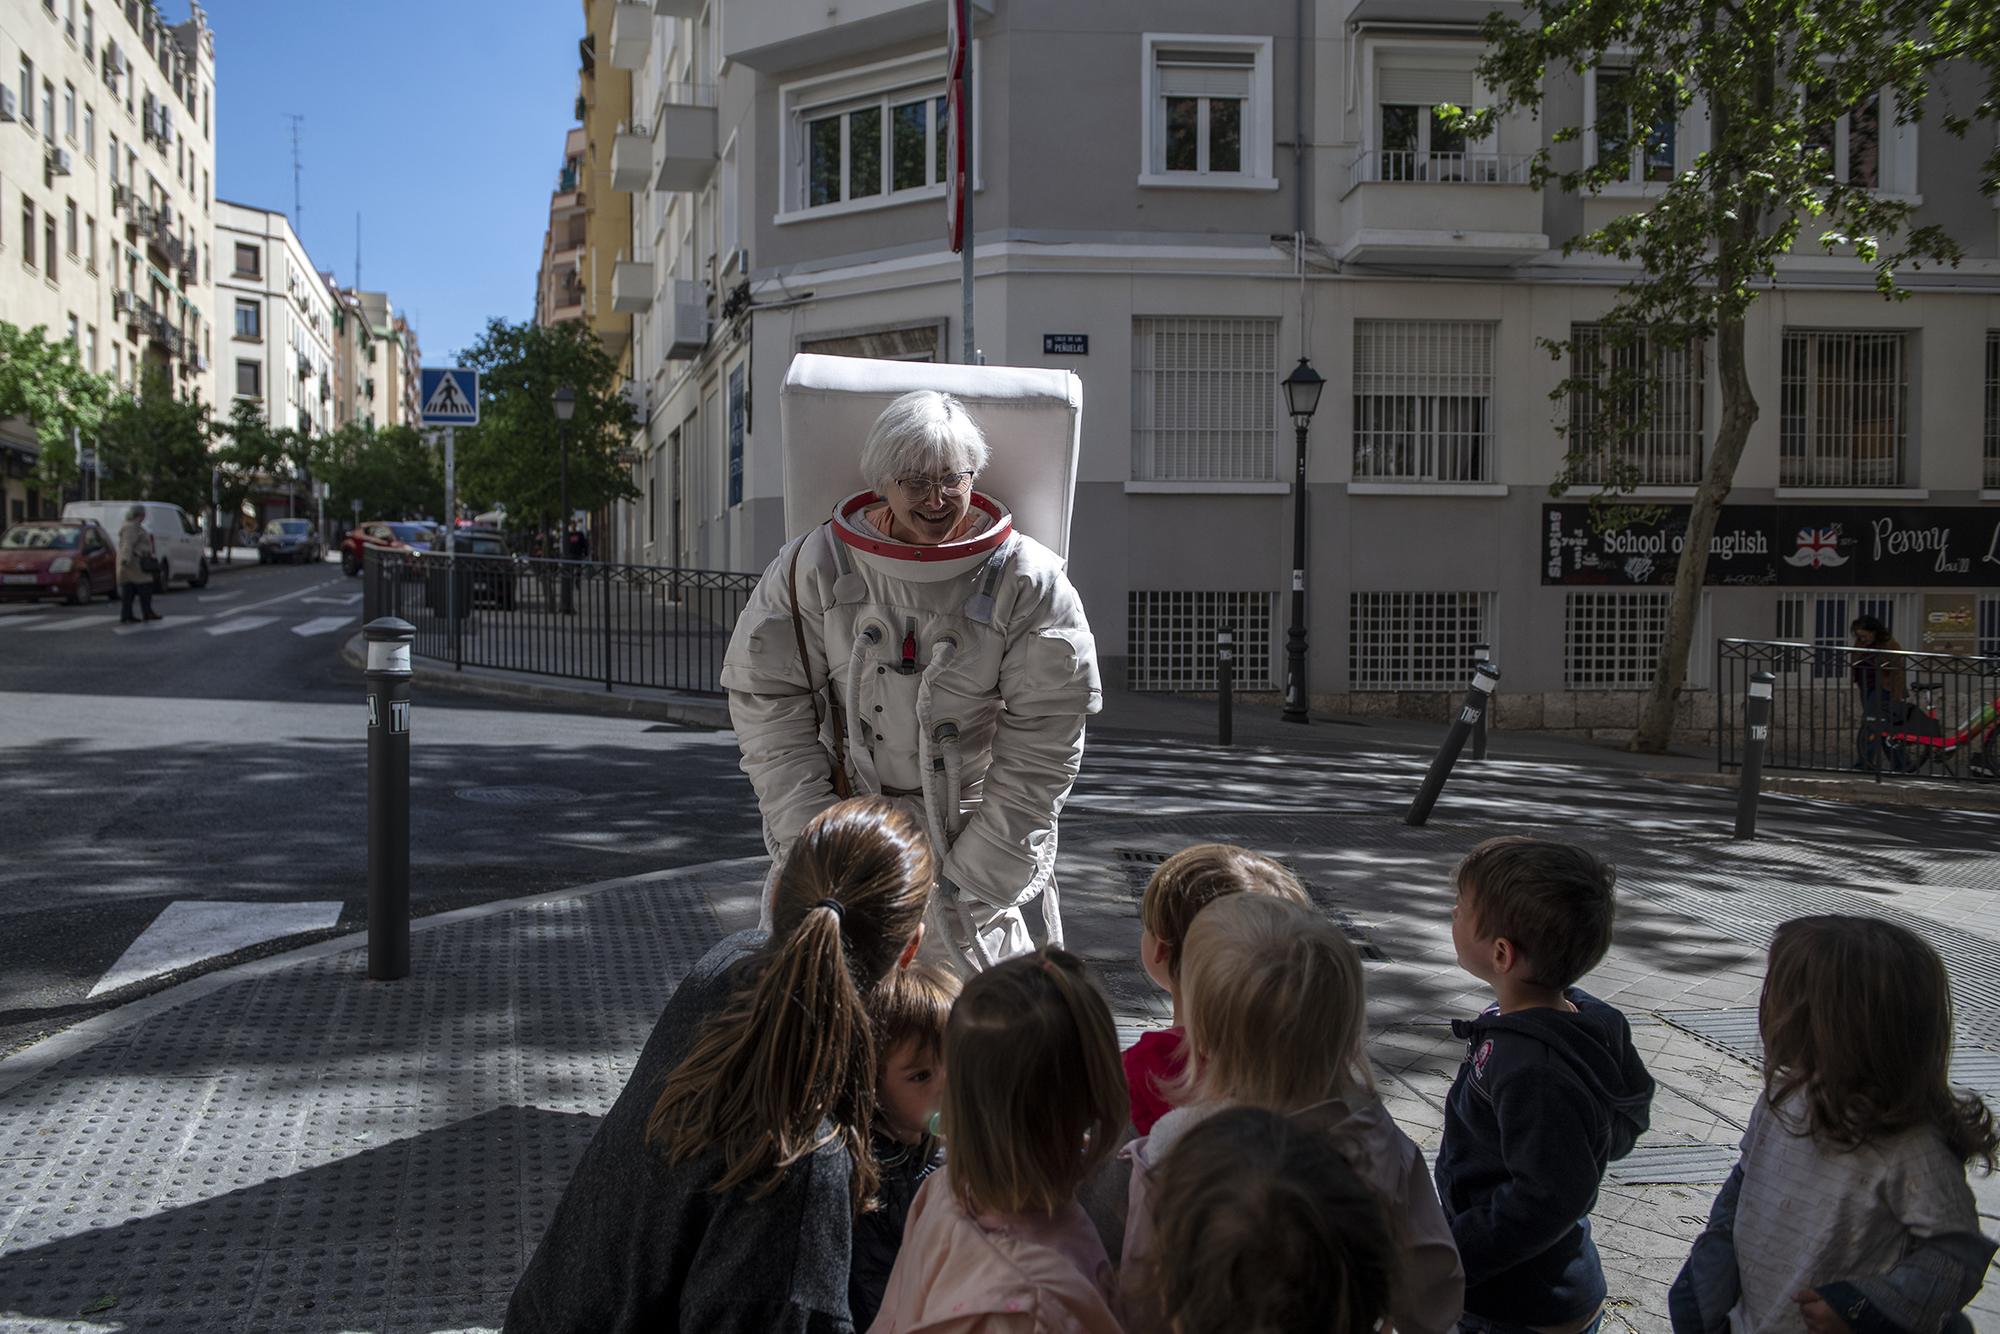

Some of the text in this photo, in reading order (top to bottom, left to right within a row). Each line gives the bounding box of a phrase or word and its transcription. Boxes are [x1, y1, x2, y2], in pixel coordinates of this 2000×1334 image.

[1054, 342, 1084, 353] PEÑUELAS
[1548, 510, 1562, 578] Shaping
[1561, 537, 1589, 546] your
[1603, 528, 1667, 554] School
[1670, 534, 1687, 554] o
[1709, 529, 1769, 560] nglish
[1871, 516, 1951, 573] Penny
